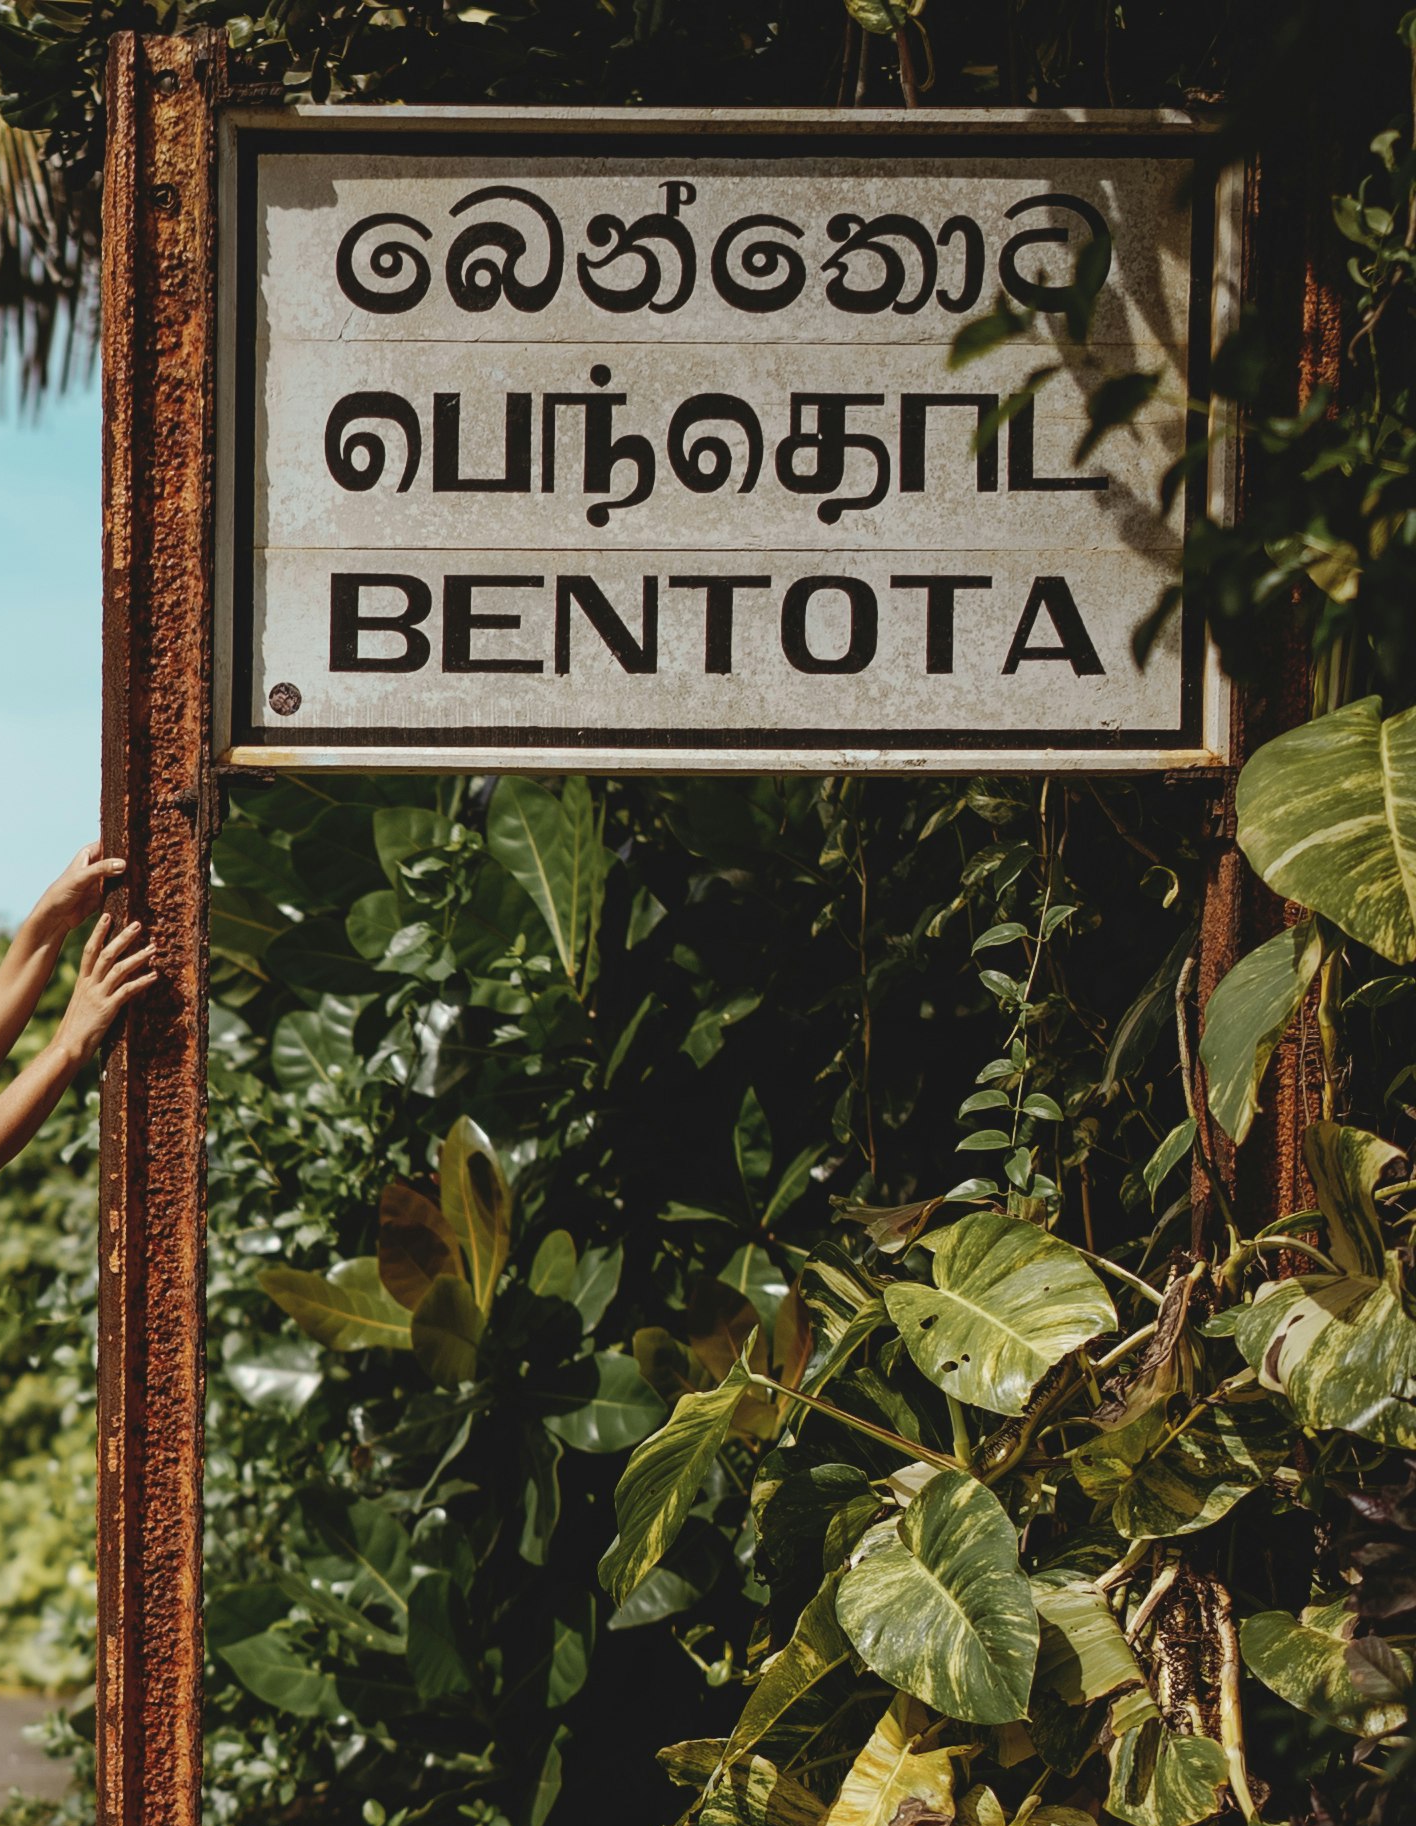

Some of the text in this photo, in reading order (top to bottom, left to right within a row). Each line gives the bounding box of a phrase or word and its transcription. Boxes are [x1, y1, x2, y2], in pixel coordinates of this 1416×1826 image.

[336, 180, 1111, 315] බෙන්තොට
[324, 363, 1109, 528] பெந்தொட
[329, 573, 1106, 677] BENTOTA
